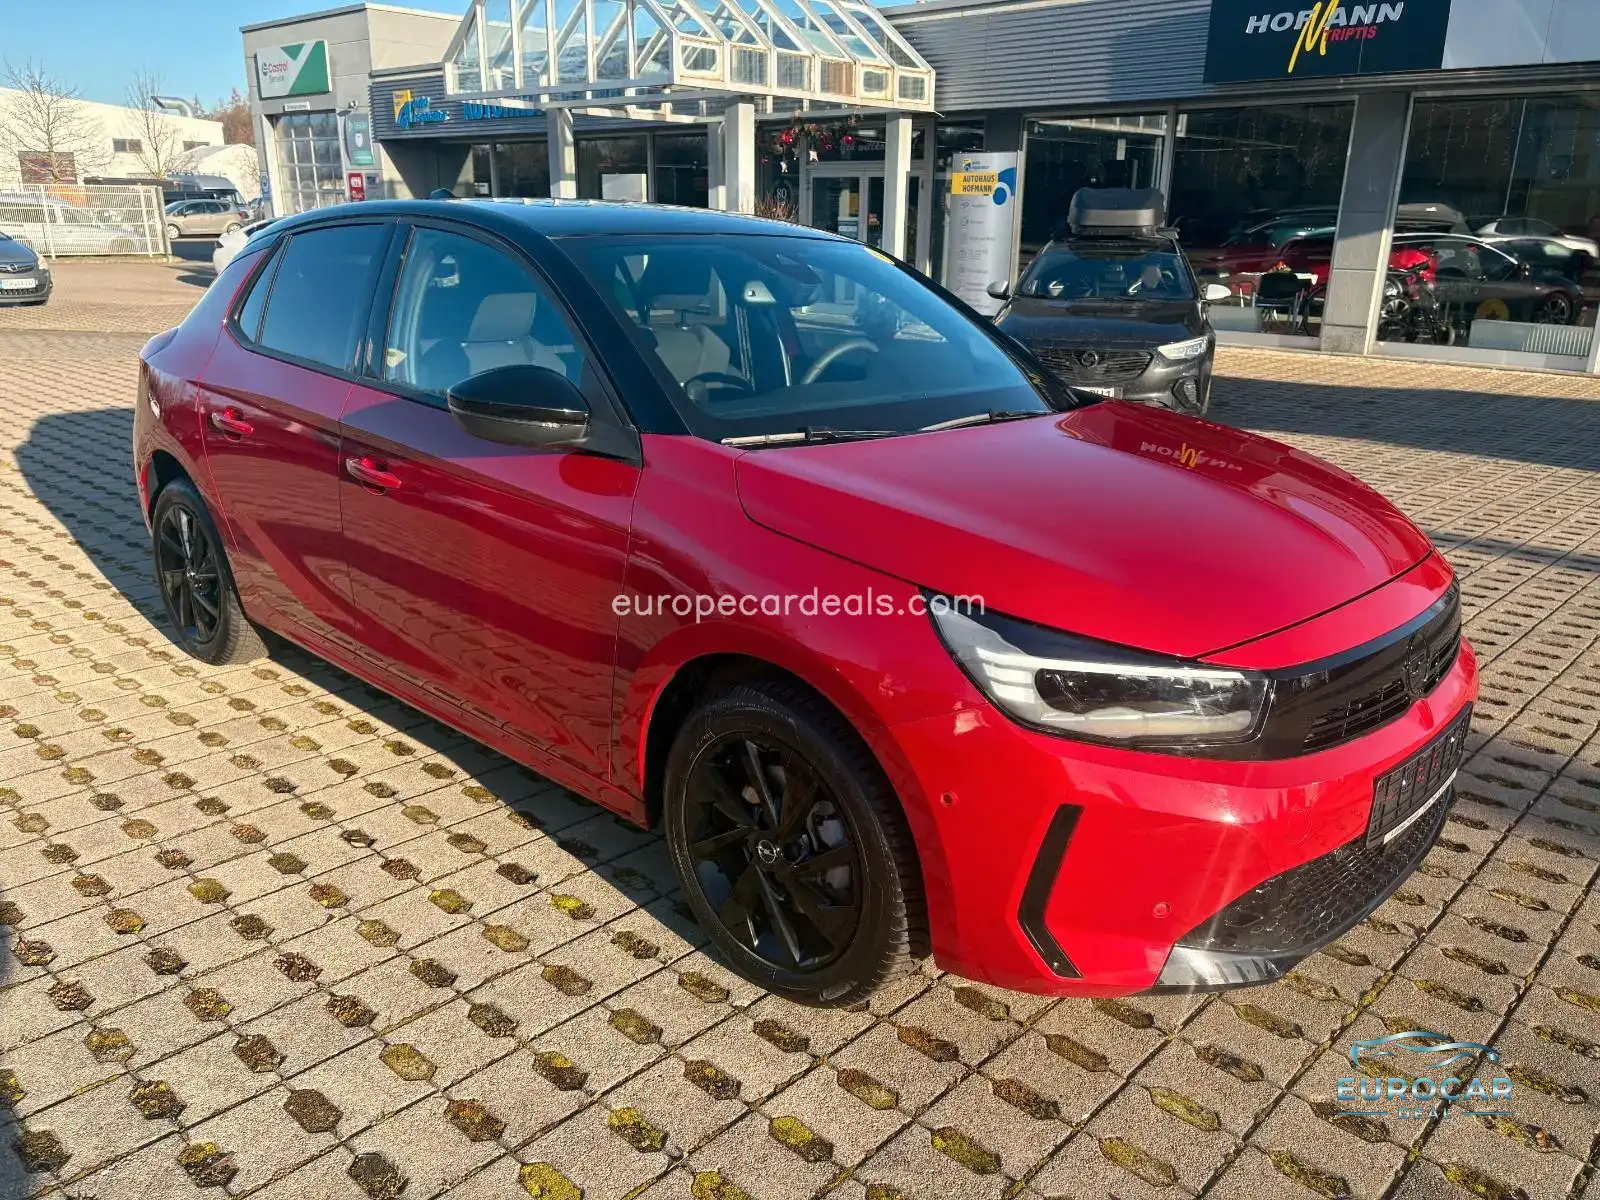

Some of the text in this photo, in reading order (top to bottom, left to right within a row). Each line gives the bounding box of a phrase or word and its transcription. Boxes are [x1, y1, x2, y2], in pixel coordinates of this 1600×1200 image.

[1325, 25, 1377, 41] TRIPTIS
[962, 175, 995, 183] AUTOHAUS
[962, 184, 992, 193] HOFMANN
